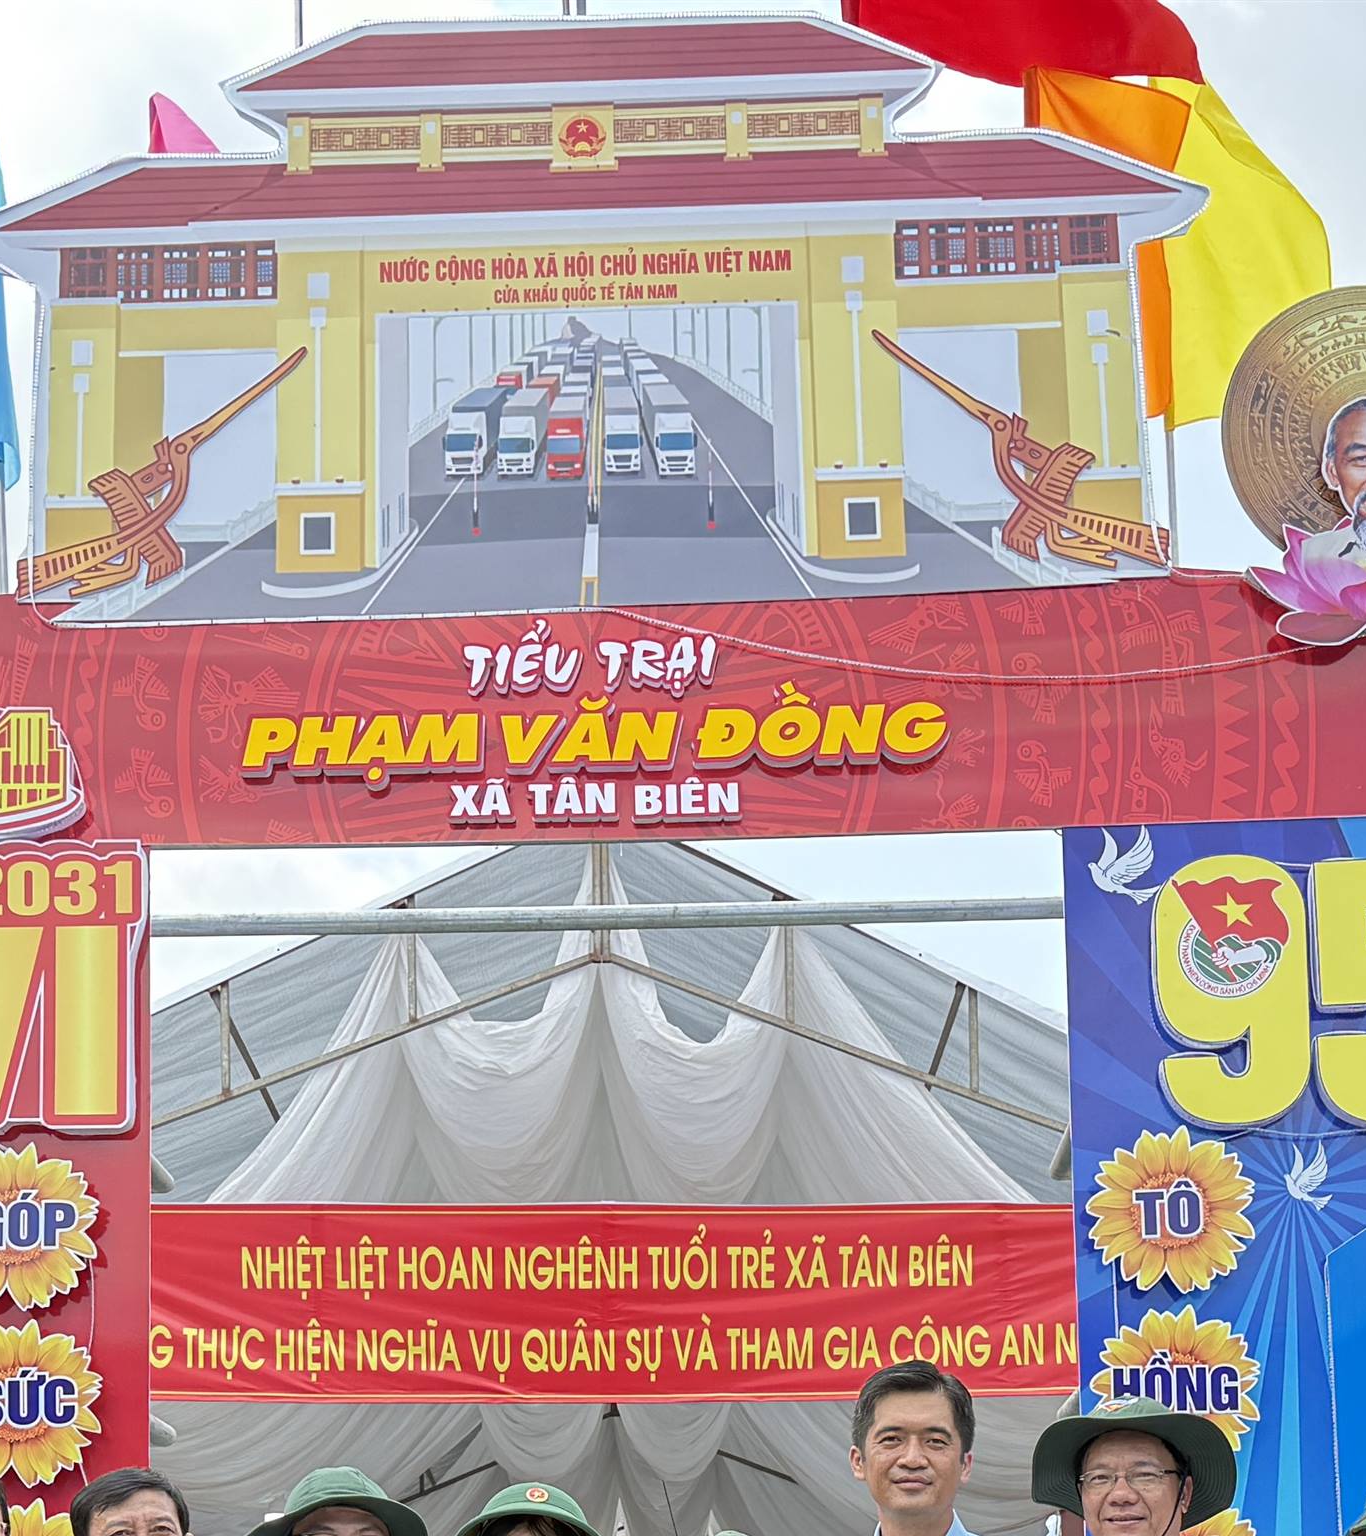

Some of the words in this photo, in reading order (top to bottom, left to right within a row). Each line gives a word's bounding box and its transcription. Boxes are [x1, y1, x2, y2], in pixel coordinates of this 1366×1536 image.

[379, 256, 430, 284] NƯỚC
[435, 255, 486, 286] CỘNG
[491, 254, 529, 280] HÒA
[534, 252, 559, 279] XÃ
[564, 251, 595, 281] HỘI
[600, 247, 637, 277] CHỦ
[642, 248, 700, 275] NGHĨA
[704, 246, 743, 277] VIỆT
[748, 249, 792, 272] NAM
[493, 284, 522, 304] CỬA
[523, 281, 558, 303] KHẨU
[562, 281, 596, 302] QUỐC
[599, 281, 616, 300] TẾ
[647, 283, 678, 299] NAM
[464, 620, 580, 692] TIỂU
[598, 634, 717, 692] TRẠI
[242, 712, 481, 782] PHẠM
[499, 696, 679, 764] VĂN
[696, 681, 949, 760] ĐỒNG
[450, 780, 511, 817] XÃ
[529, 780, 616, 816] TÂN
[631, 780, 739, 816] BIÊN
[1134, 1181, 1203, 1237] TÔ
[241, 1235, 326, 1300] NHIỆT
[335, 1235, 389, 1300] LIỆT
[398, 1246, 494, 1291] HOAN
[504, 1235, 638, 1291] NGHÊNH
[647, 1223, 717, 1290] TUỔI
[727, 1229, 776, 1289] TRẺ
[785, 1234, 830, 1289] XÃ
[838, 1234, 898, 1289] TÂN
[908, 1234, 974, 1288] BIÊN
[182, 1324, 266, 1381] THỰC
[275, 1318, 346, 1382] HIỆN
[356, 1319, 462, 1373] NGHĨA
[467, 1327, 512, 1383] VỤ
[521, 1317, 616, 1374] QUÂN
[624, 1325, 664, 1382] SỰ
[671, 1313, 719, 1372] VÀ
[726, 1326, 814, 1371] THAM
[823, 1325, 878, 1370] GIA
[889, 1314, 992, 1368] CÔNG
[998, 1322, 1045, 1366] AN
[1112, 1351, 1240, 1412] HỒNG
